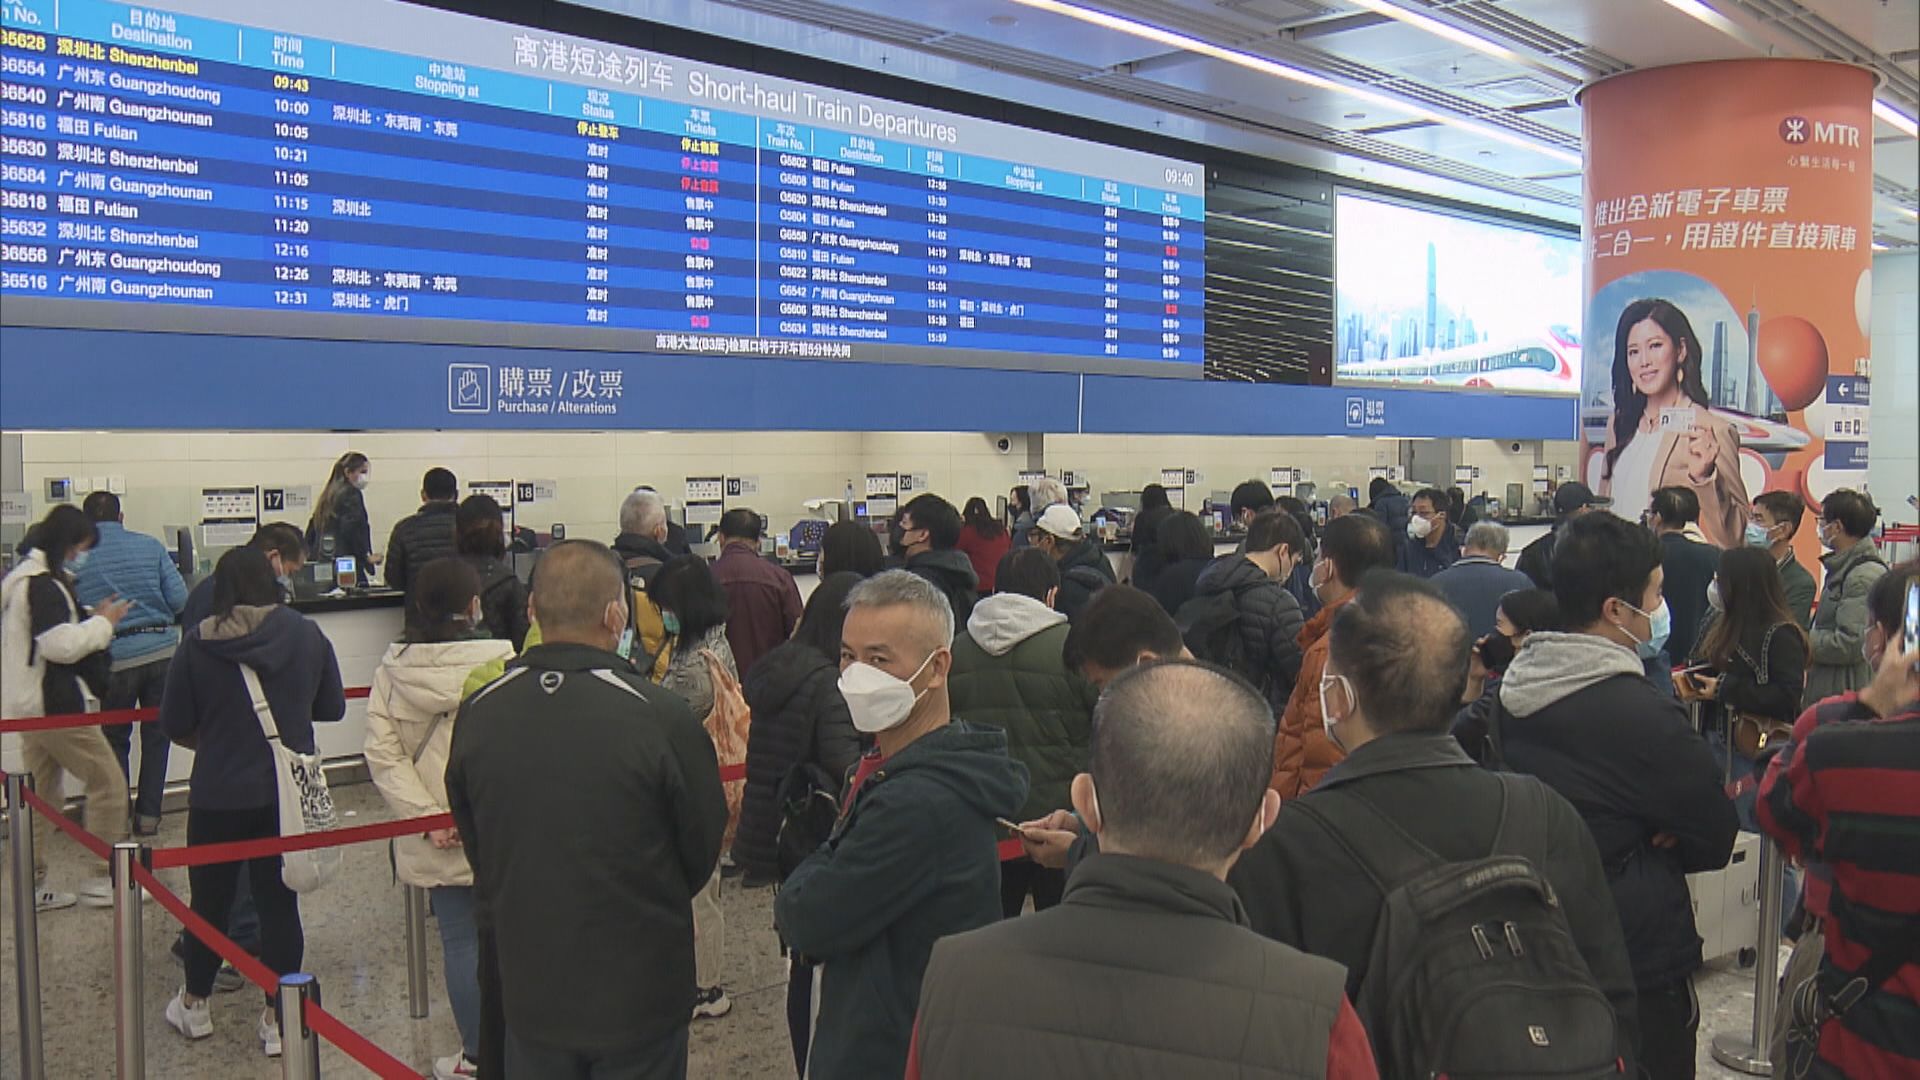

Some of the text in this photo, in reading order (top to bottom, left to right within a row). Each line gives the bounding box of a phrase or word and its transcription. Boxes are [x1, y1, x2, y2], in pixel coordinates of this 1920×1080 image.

[14, 7, 40, 24] No.
[131, 9, 175, 32] 目的地
[112, 23, 193, 50] Destination
[274, 36, 301, 54] 时间
[57, 38, 198, 74] 深圳北 Shenzhenbei
[272, 51, 304, 68] Time
[58, 65, 220, 104] 广州东 Guangzhoudong
[274, 75, 308, 92] 09:43
[416, 76, 480, 98] Stopping at
[513, 33, 957, 144] 离港短途列车 Short-haul Train Departures
[57, 91, 212, 126] 广州南 Guangzhounan
[276, 100, 308, 114] 10:00
[583, 104, 614, 119] Status
[58, 116, 137, 140] 福田 Futian
[275, 124, 308, 139] 10:05
[685, 120, 716, 136] Tickets
[1814, 121, 1860, 148] MTR
[768, 134, 804, 150] Train No.
[58, 143, 198, 174] 深圳北 Shenzhenbei
[275, 147, 306, 161] 10:21
[841, 147, 883, 163] Destination
[831, 163, 854, 176] Futian
[927, 162, 944, 173] Time
[58, 170, 212, 200] 广州南 Guangzhounan
[275, 171, 308, 186] 11:05
[1165, 168, 1194, 186] 09:40
[832, 181, 854, 192] Futian
[58, 196, 137, 218] 福田 Futian
[275, 196, 308, 209] 11:15
[839, 199, 886, 216] Shenzhenbei
[1594, 187, 1790, 228] 推出全新電子車票
[275, 219, 308, 233] 11:20
[831, 216, 854, 228] Futian
[59, 223, 198, 248] 深圳北 Shenzhenbei
[275, 244, 308, 257] 12:16
[839, 235, 898, 254] Guangzhoudong
[58, 248, 220, 277] 广州东 Guangzhoudong
[832, 254, 854, 264] Futian
[275, 267, 308, 280] 12:26
[839, 271, 886, 285] Shenzhenbei
[59, 276, 212, 298] 广州南 Guangzhounan
[275, 291, 306, 303] 12:31
[839, 290, 894, 303] Guangzhounan
[839, 307, 887, 321] Shenzhenbei
[839, 326, 886, 338] Shenzhenbei
[498, 400, 549, 414] Purchase
[558, 401, 617, 415] Alterations
[728, 481, 738, 492] 19
[901, 478, 911, 488] 20
[265, 493, 282, 507] 17
[519, 487, 532, 498] 18
